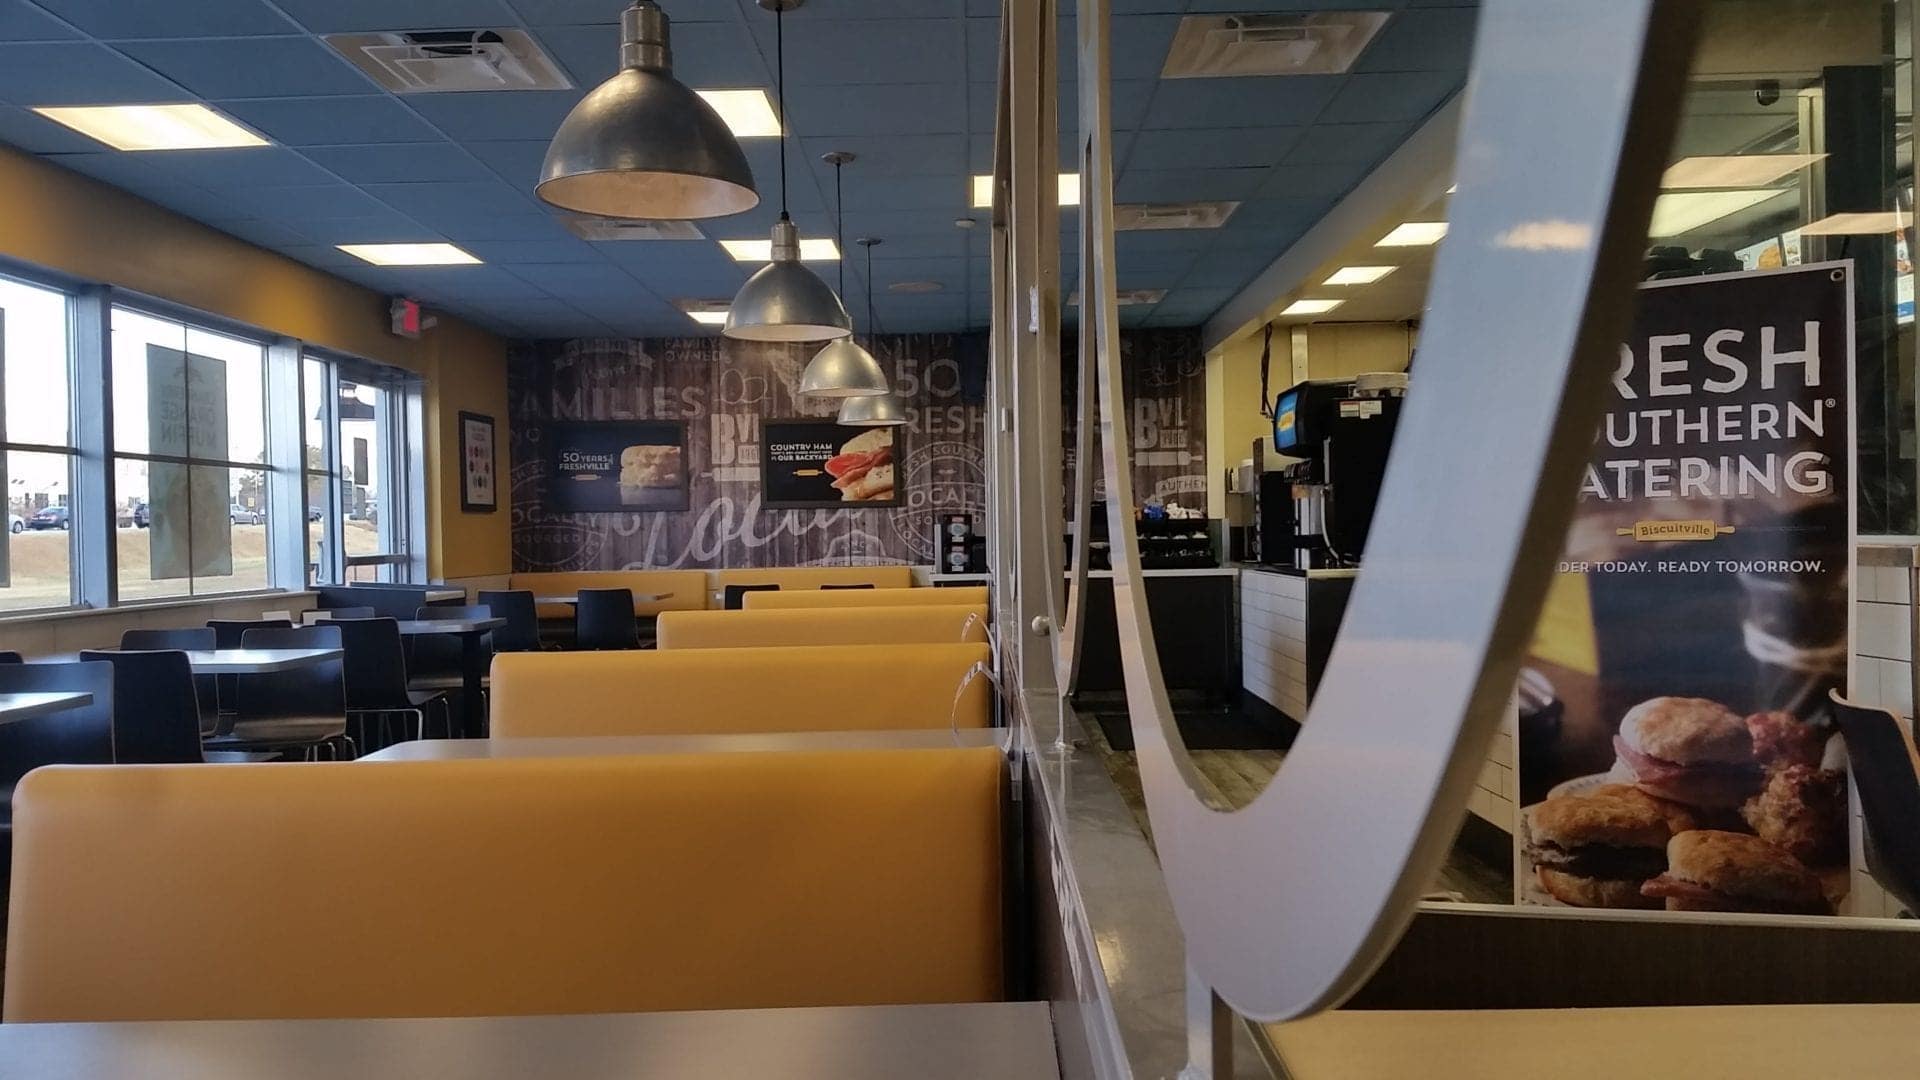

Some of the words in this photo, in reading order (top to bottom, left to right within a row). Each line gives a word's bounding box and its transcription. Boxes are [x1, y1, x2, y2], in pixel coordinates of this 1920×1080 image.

[1611, 321, 1821, 399] RESH
[895, 359, 961, 398] 50
[512, 386, 706, 420] AMILIES
[902, 405, 985, 434] RESH
[770, 443, 811, 451] COUNTRY
[813, 442, 833, 450] HAM
[562, 452, 579, 462] 50
[580, 454, 608, 462] YEARS
[558, 463, 610, 471] FRESHVILLE
[1579, 451, 1828, 499] ATERING
[1160, 477, 1206, 492] AUTHEN
[511, 506, 598, 528] OCALLY
[1641, 524, 1711, 536] Biscuitville
[1559, 561, 1590, 573] DER
[1595, 561, 1651, 573] TODAY.
[1657, 560, 1711, 573] READY
[1716, 560, 1826, 573] TOMORROW.
